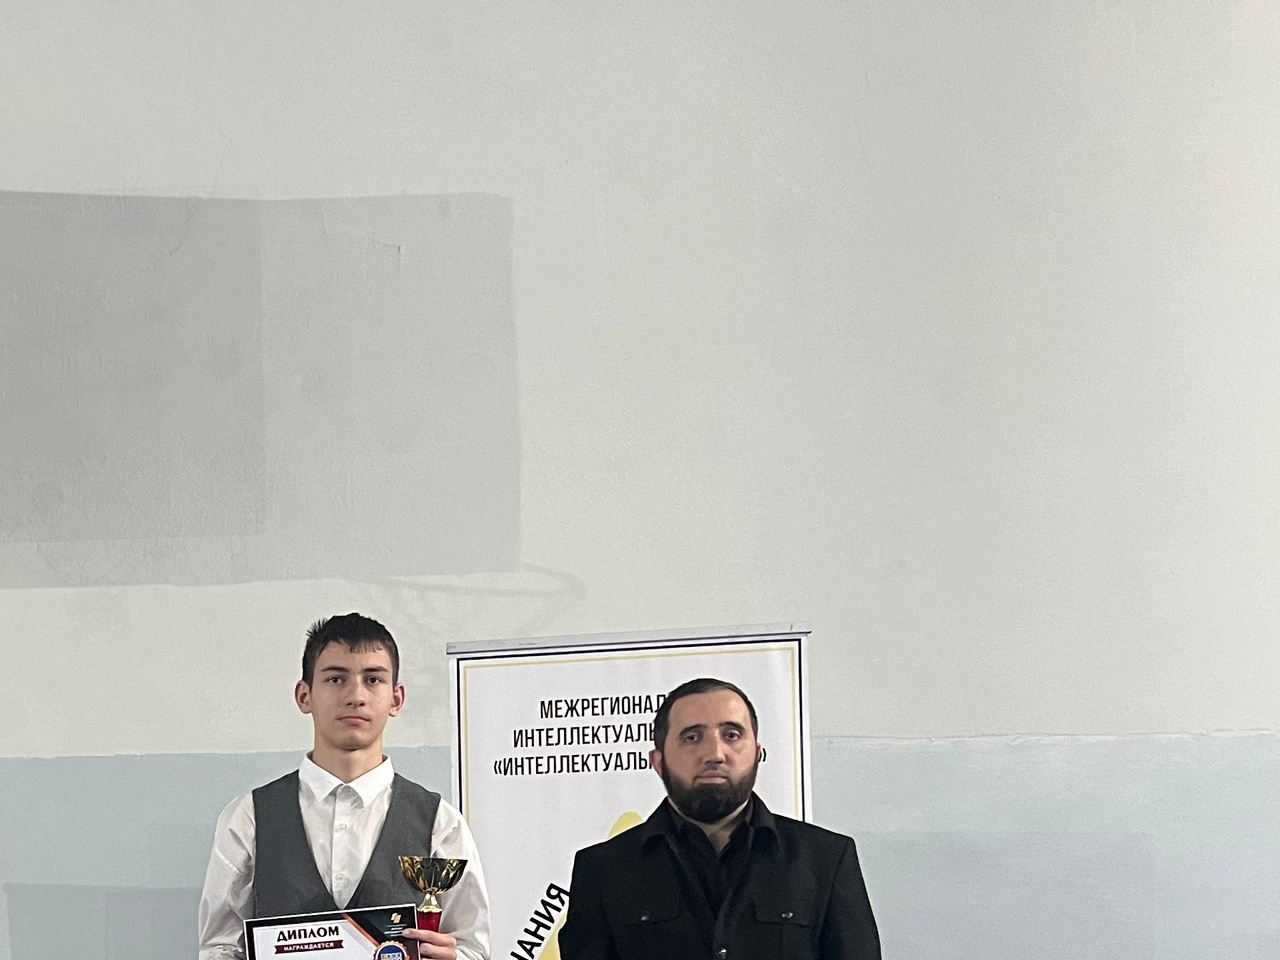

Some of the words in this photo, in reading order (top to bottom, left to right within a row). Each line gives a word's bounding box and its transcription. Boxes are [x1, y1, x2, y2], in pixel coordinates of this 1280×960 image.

[493, 751, 653, 776] «ИНТЕЛЛЕКТУАЛЬ
[277, 926, 339, 942] ДИПЛОМ
[283, 942, 335, 951] НАГРАЖДАЕТСЯ
